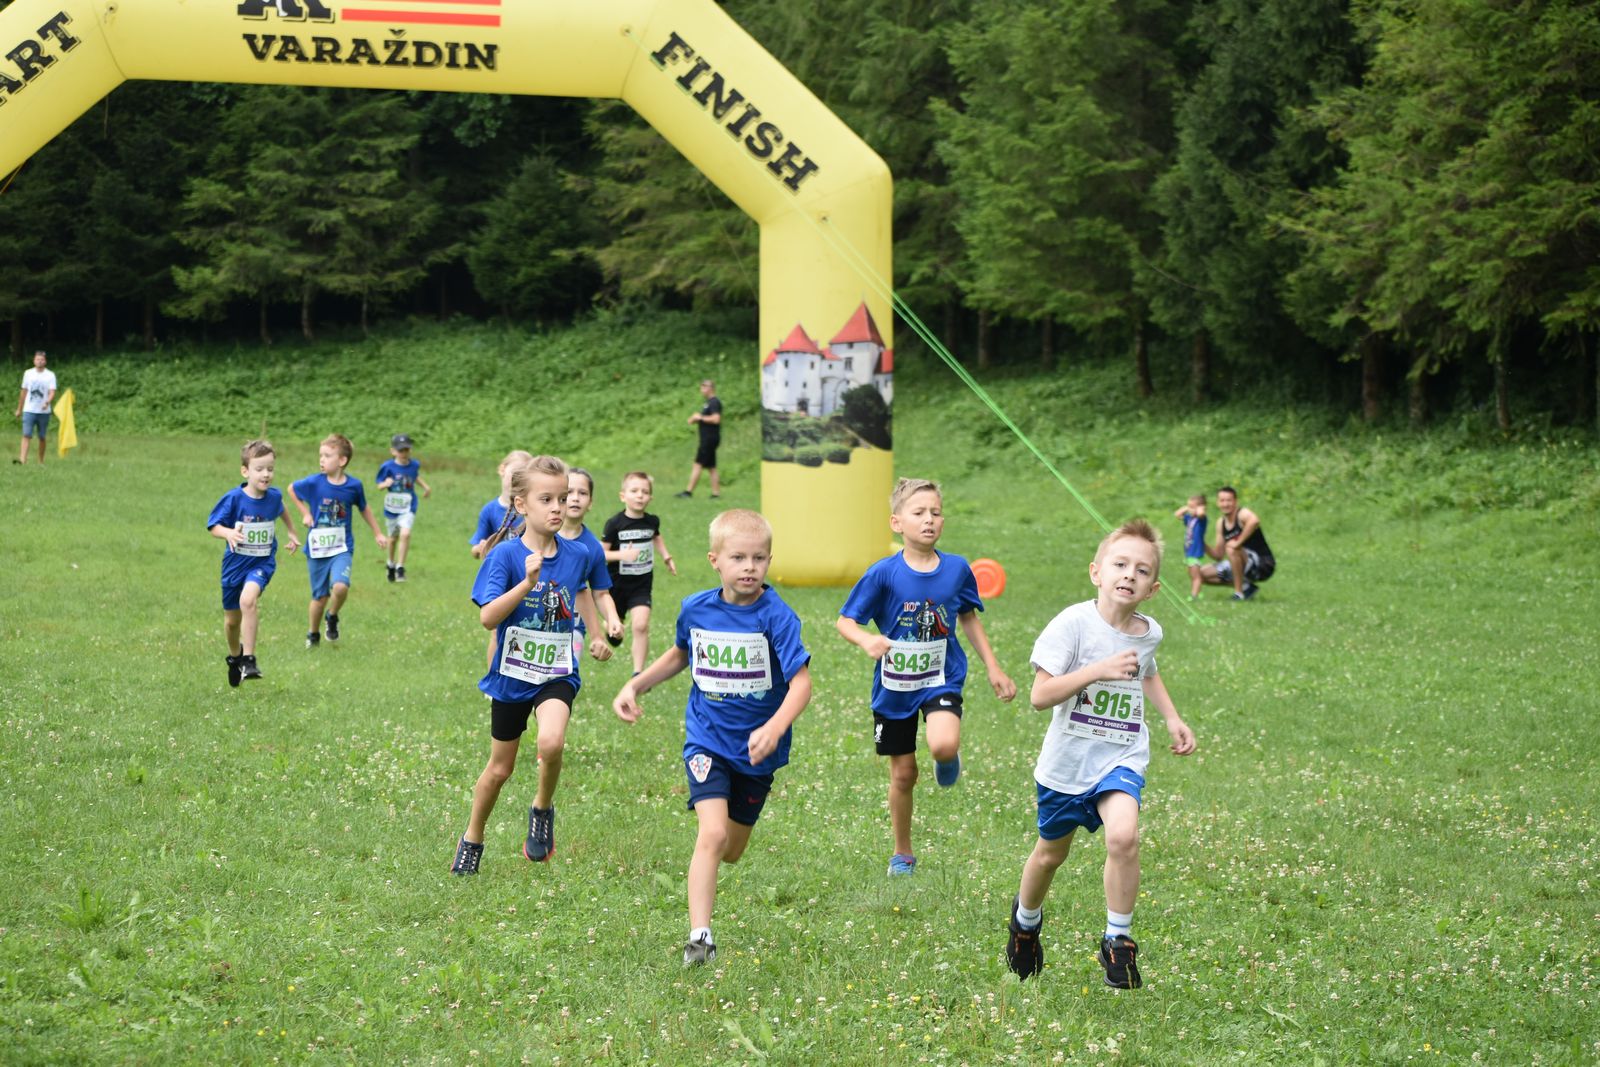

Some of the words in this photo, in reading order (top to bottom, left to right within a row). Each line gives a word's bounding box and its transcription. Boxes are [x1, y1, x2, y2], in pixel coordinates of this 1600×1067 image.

[242, 29, 498, 71] VARAŽDIN
[650, 31, 819, 194] FINISH
[247, 530, 269, 544] 919
[319, 534, 337, 547] 917
[523, 641, 556, 665] 916
[707, 644, 748, 669] 944
[893, 652, 930, 672] 943
[1093, 690, 1132, 720] 915
